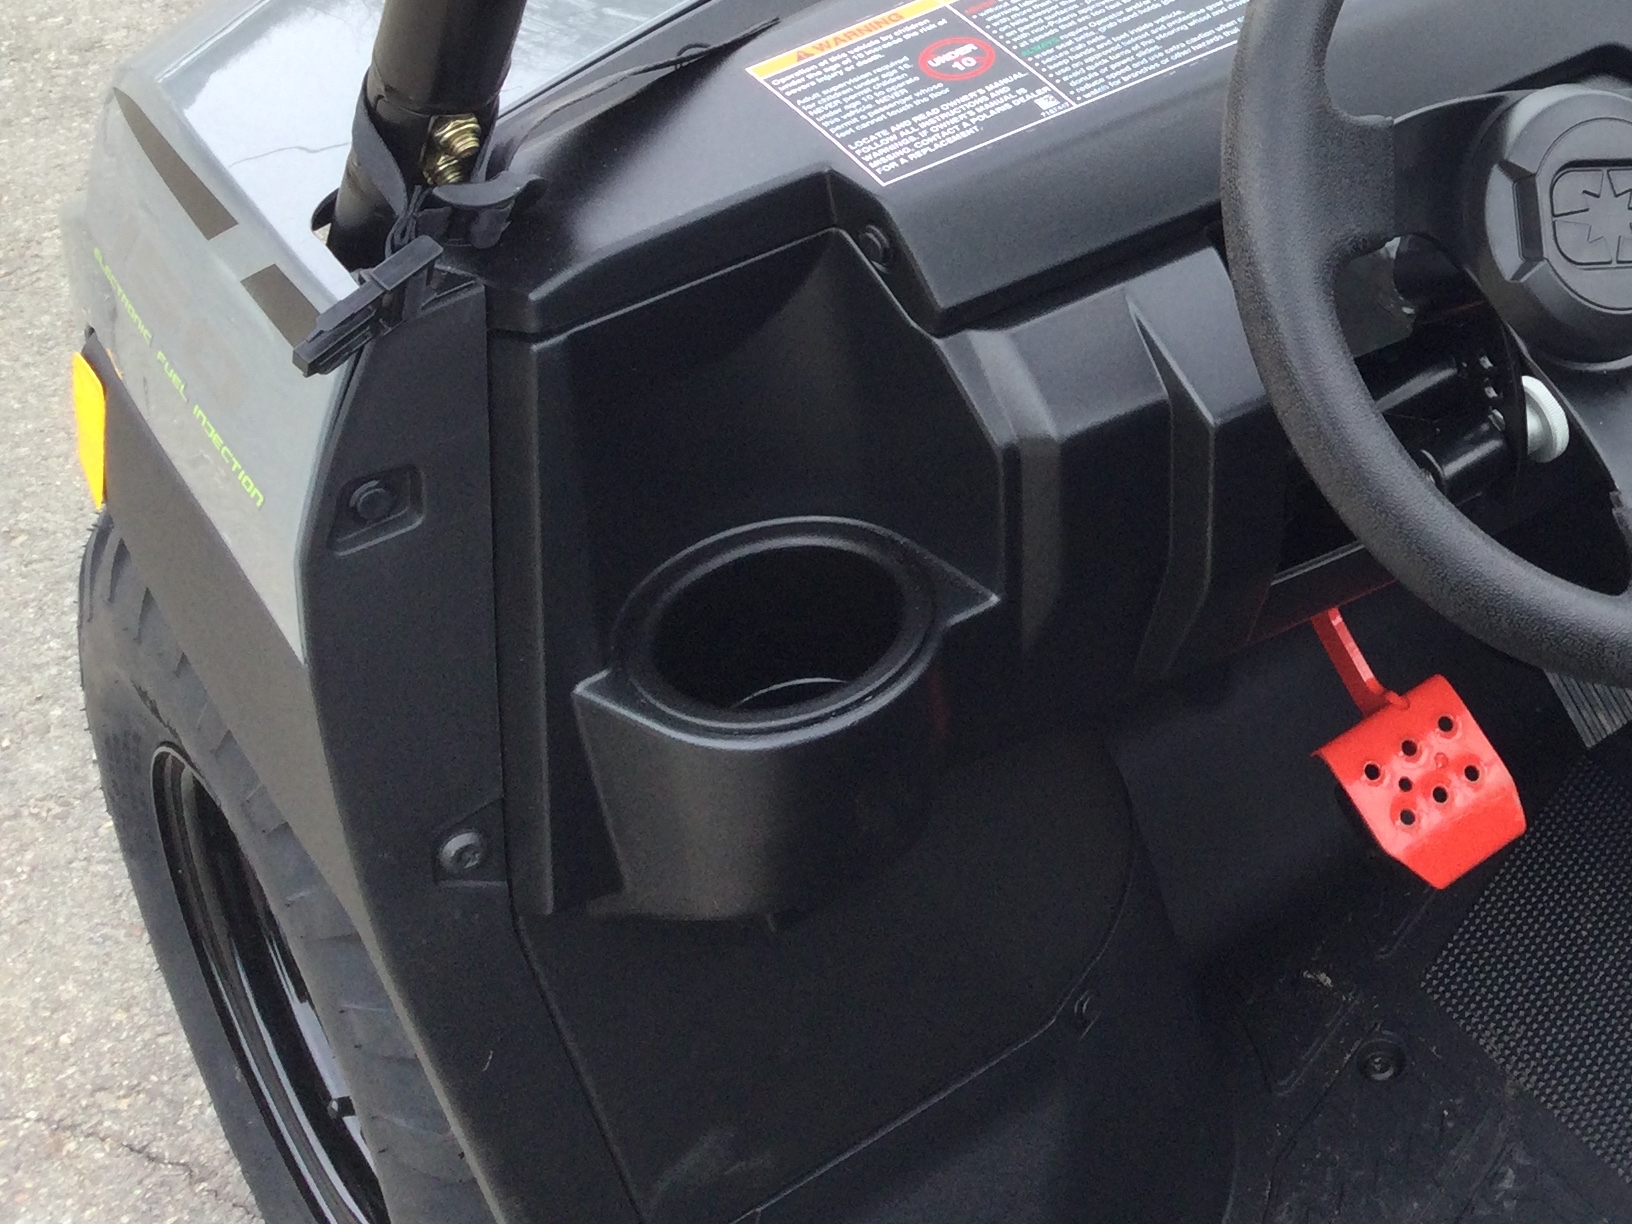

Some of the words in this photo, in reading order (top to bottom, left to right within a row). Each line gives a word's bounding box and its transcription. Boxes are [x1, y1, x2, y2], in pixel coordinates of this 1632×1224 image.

[811, 11, 904, 52] WARNING
[925, 42, 978, 66] UNDER
[948, 55, 978, 71] 10
[156, 350, 189, 402] FUEL
[192, 404, 265, 508] INJECTION
